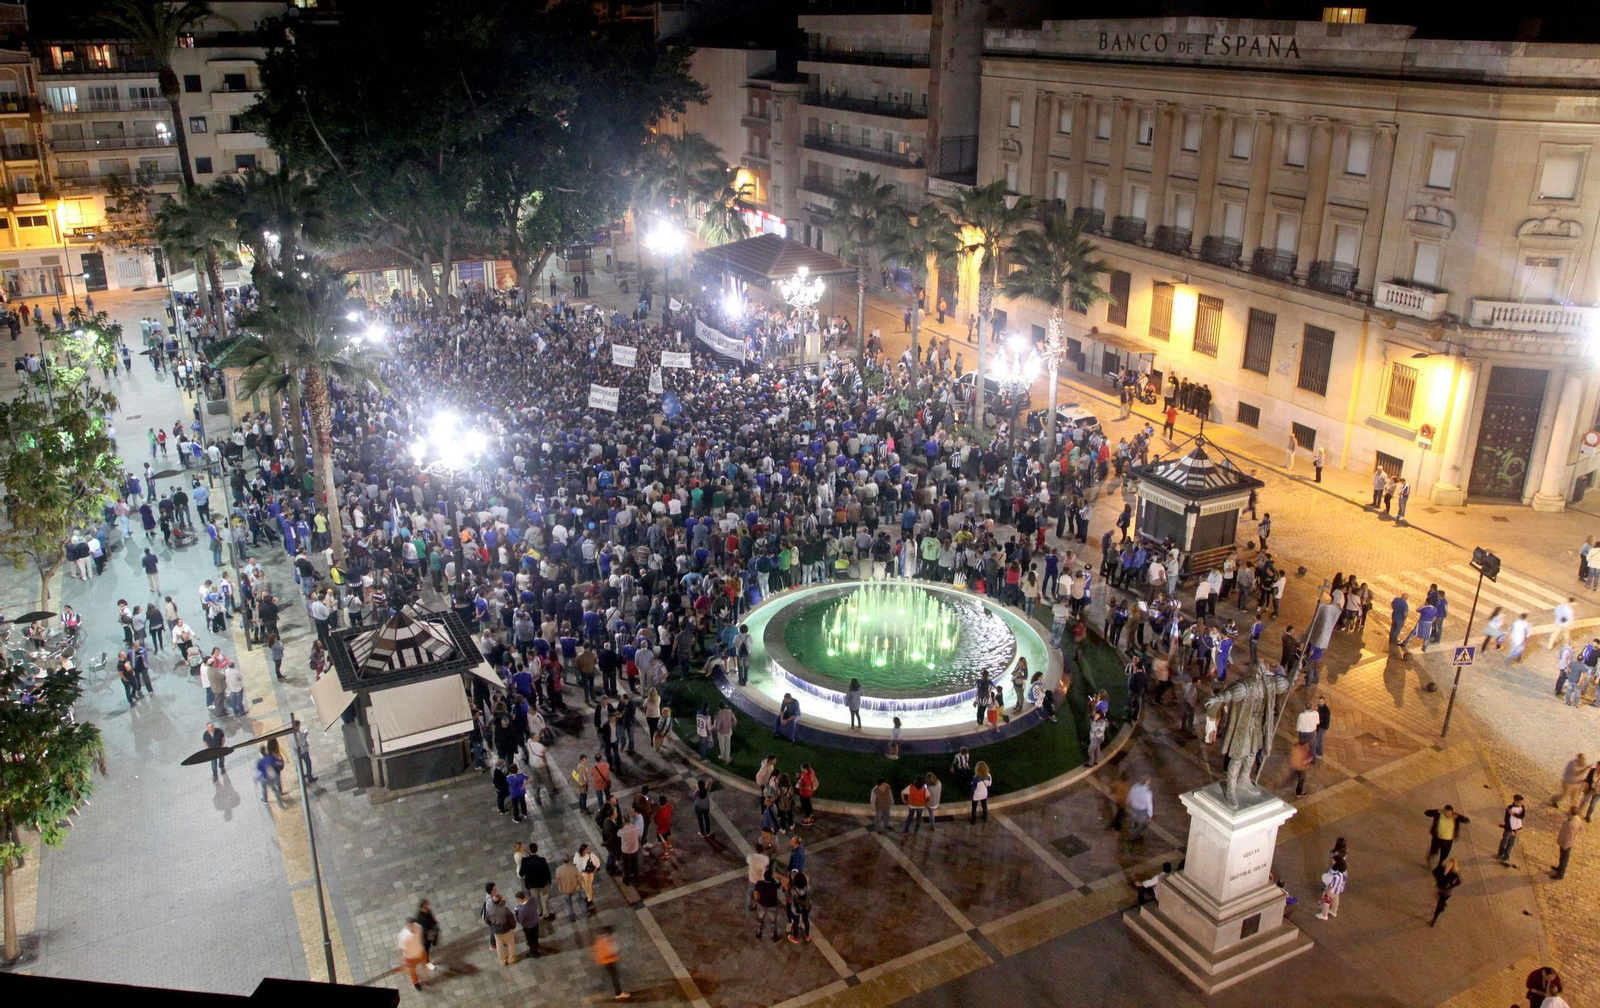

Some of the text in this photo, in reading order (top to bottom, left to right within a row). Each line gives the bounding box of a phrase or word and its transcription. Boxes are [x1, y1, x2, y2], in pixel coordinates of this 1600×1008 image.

[1099, 32, 1301, 59] BANCO DE ESPAÑA
[1243, 848, 1260, 858] HUELVA
